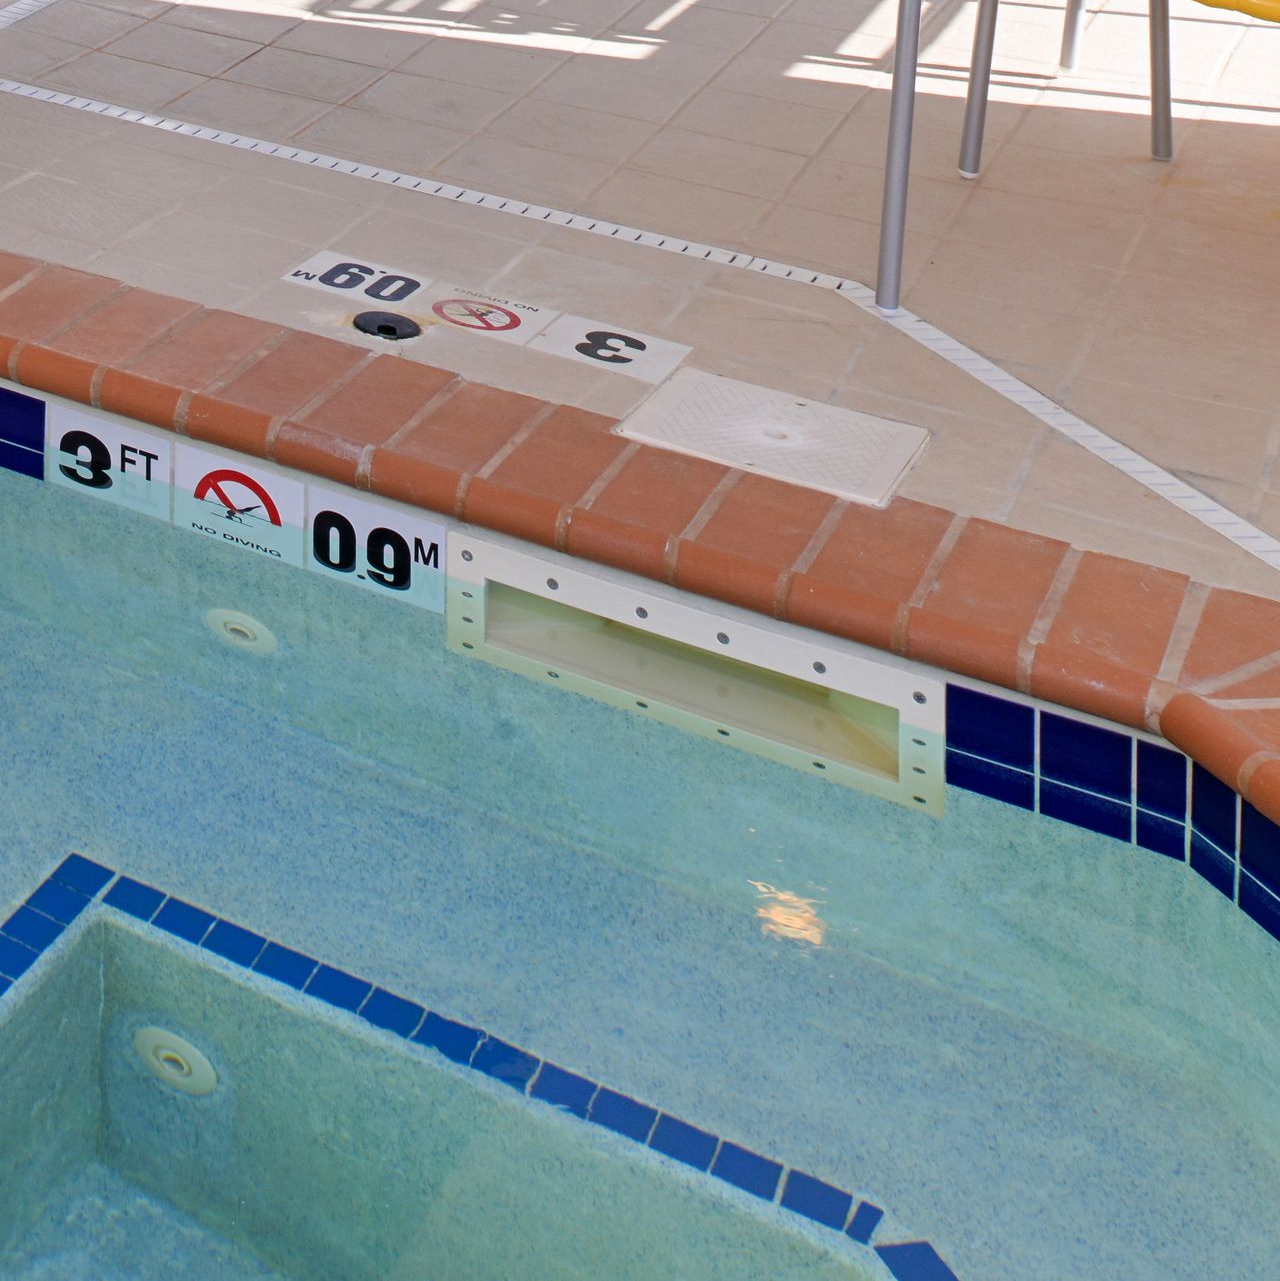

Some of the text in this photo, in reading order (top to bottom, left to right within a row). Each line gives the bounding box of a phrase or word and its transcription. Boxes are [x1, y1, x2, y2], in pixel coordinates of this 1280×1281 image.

[291, 263, 421, 301] 0.9 M
[454, 288, 539, 312] NO DIVING
[575, 331, 647, 364] 3
[60, 431, 159, 489] 3 FT
[192, 522, 282, 557] NO DIVING
[313, 511, 440, 591] 0.9 M
